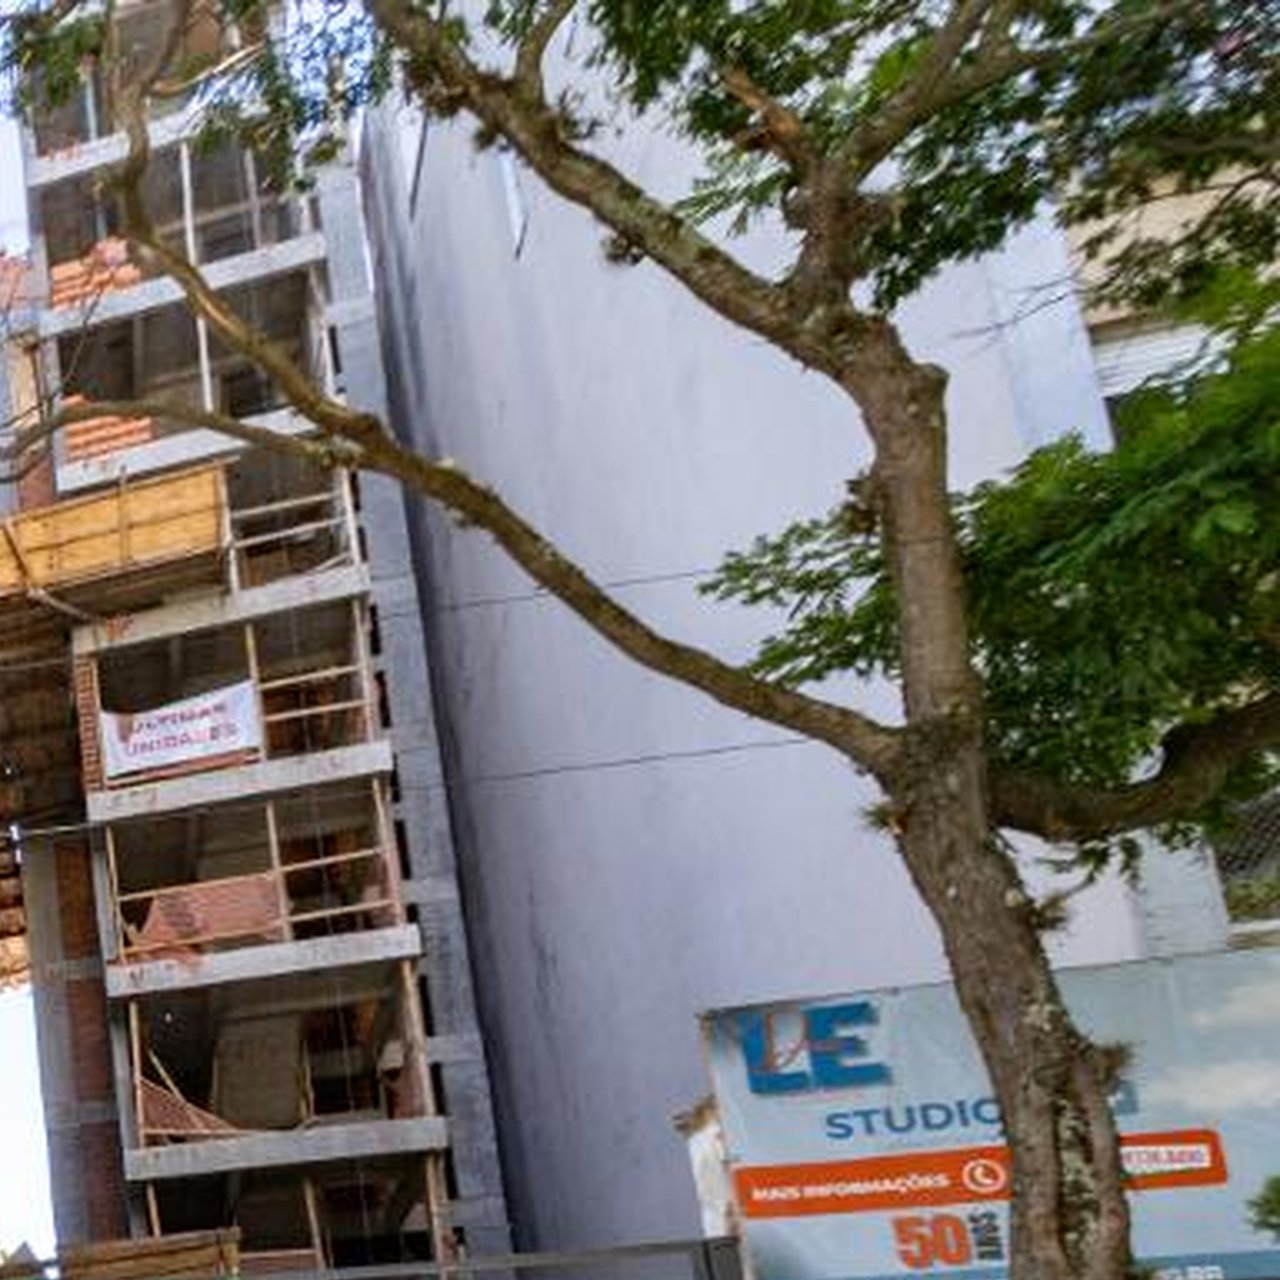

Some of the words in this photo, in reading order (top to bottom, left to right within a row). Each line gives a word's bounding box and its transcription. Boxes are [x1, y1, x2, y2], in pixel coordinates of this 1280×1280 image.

[752, 1186, 801, 1201] MAIS
[803, 1173, 951, 1198] INFORMAÇÕES
[893, 1214, 973, 1270] 50
